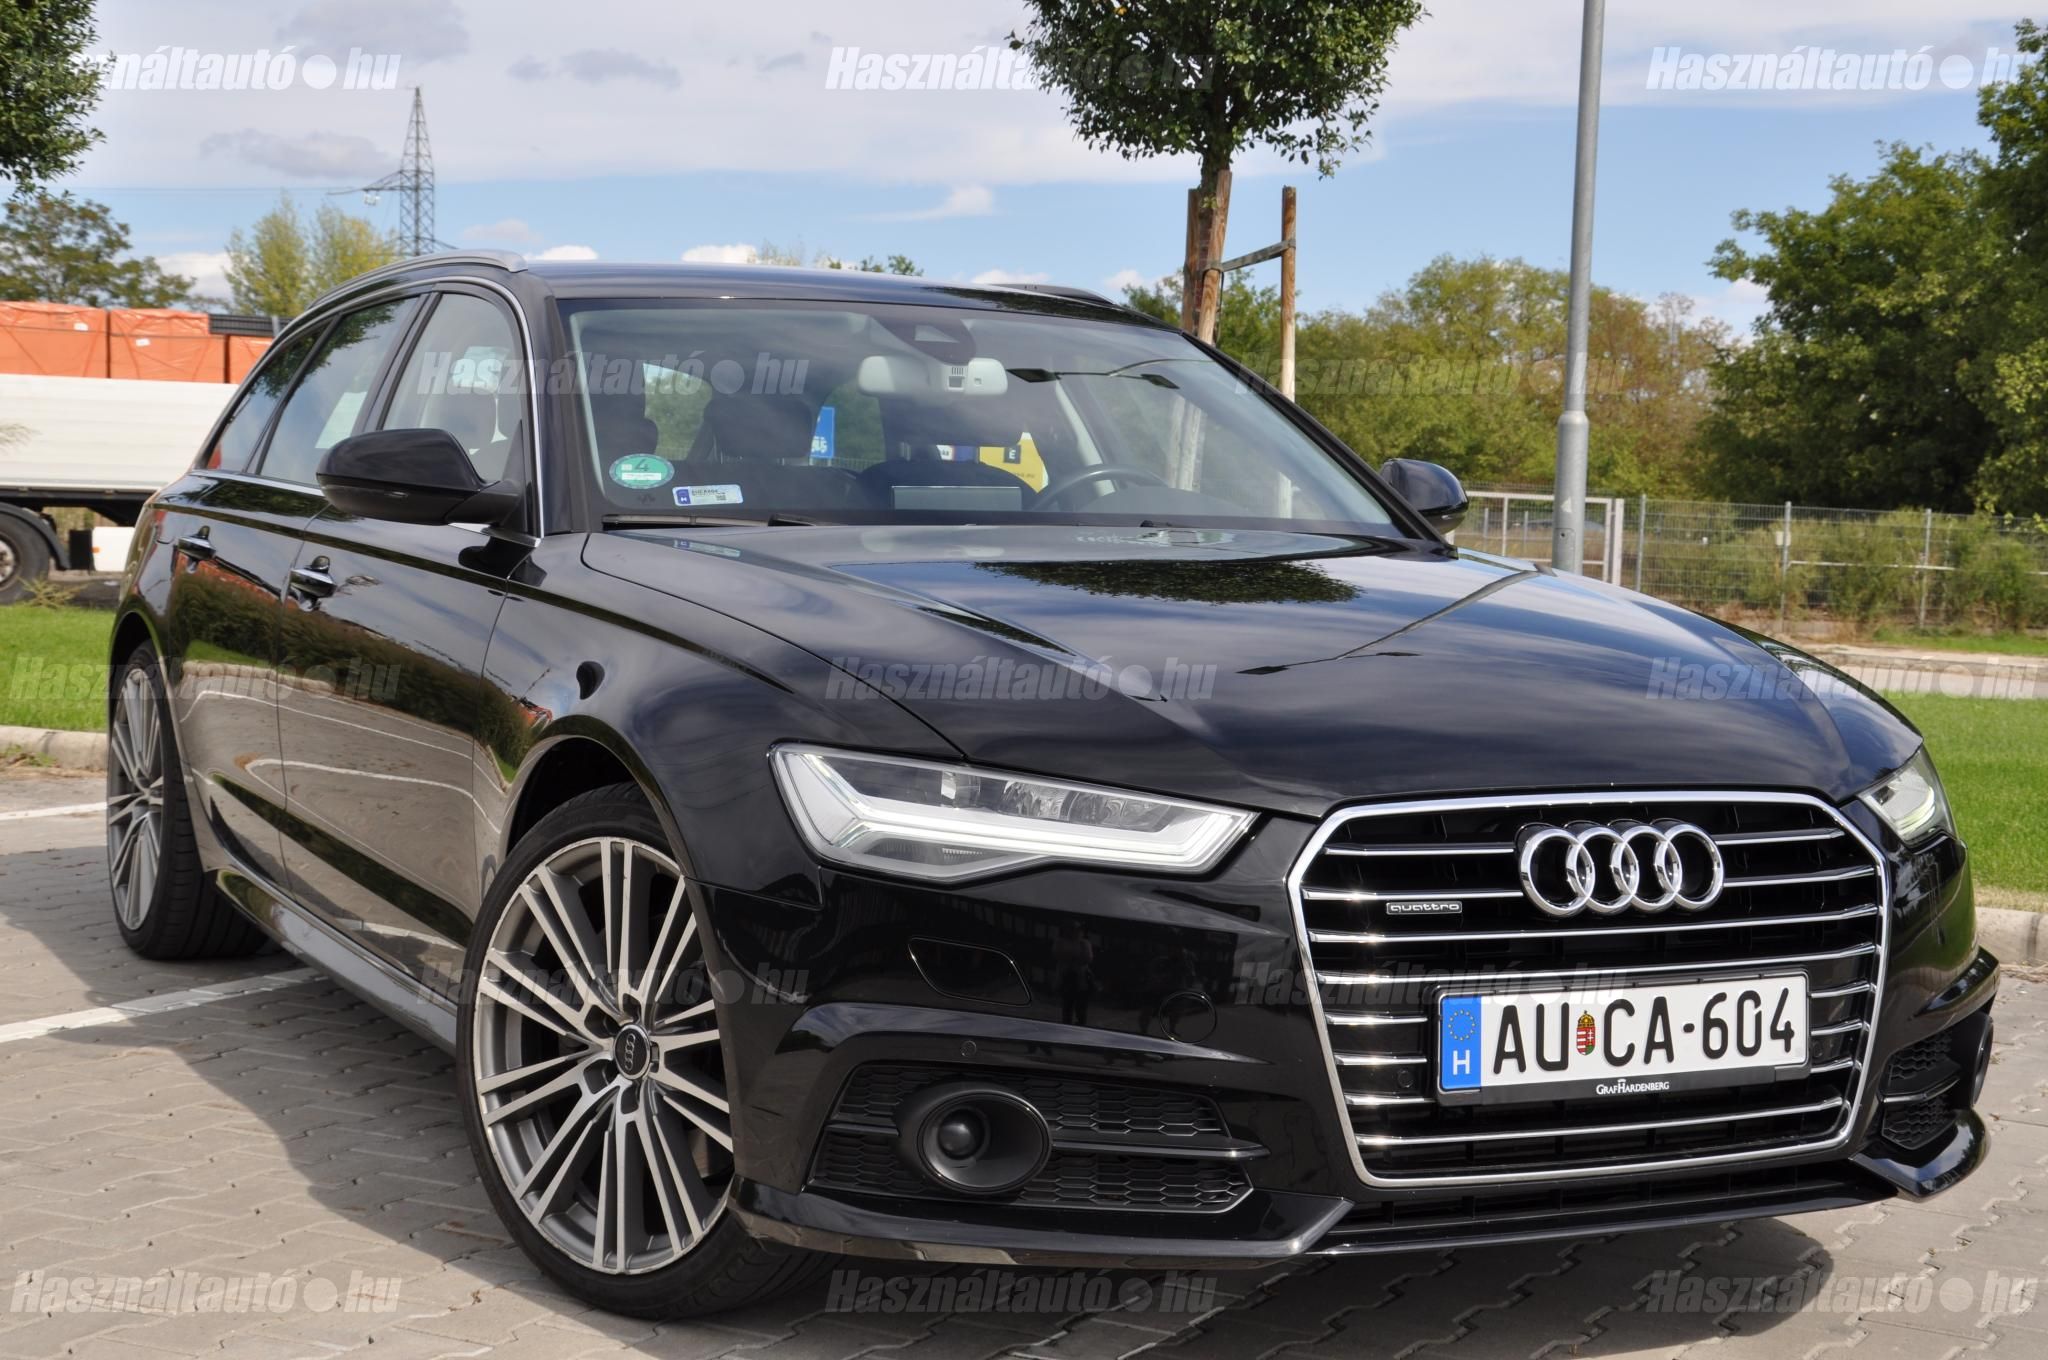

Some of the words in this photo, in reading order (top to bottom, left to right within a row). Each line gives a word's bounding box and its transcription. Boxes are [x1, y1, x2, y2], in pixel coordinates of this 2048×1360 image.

[634, 458, 649, 472] 4
[1390, 903, 1460, 913] quattro
[1603, 987, 1795, 1067] CA-604
[1452, 1049, 1471, 1076] H
